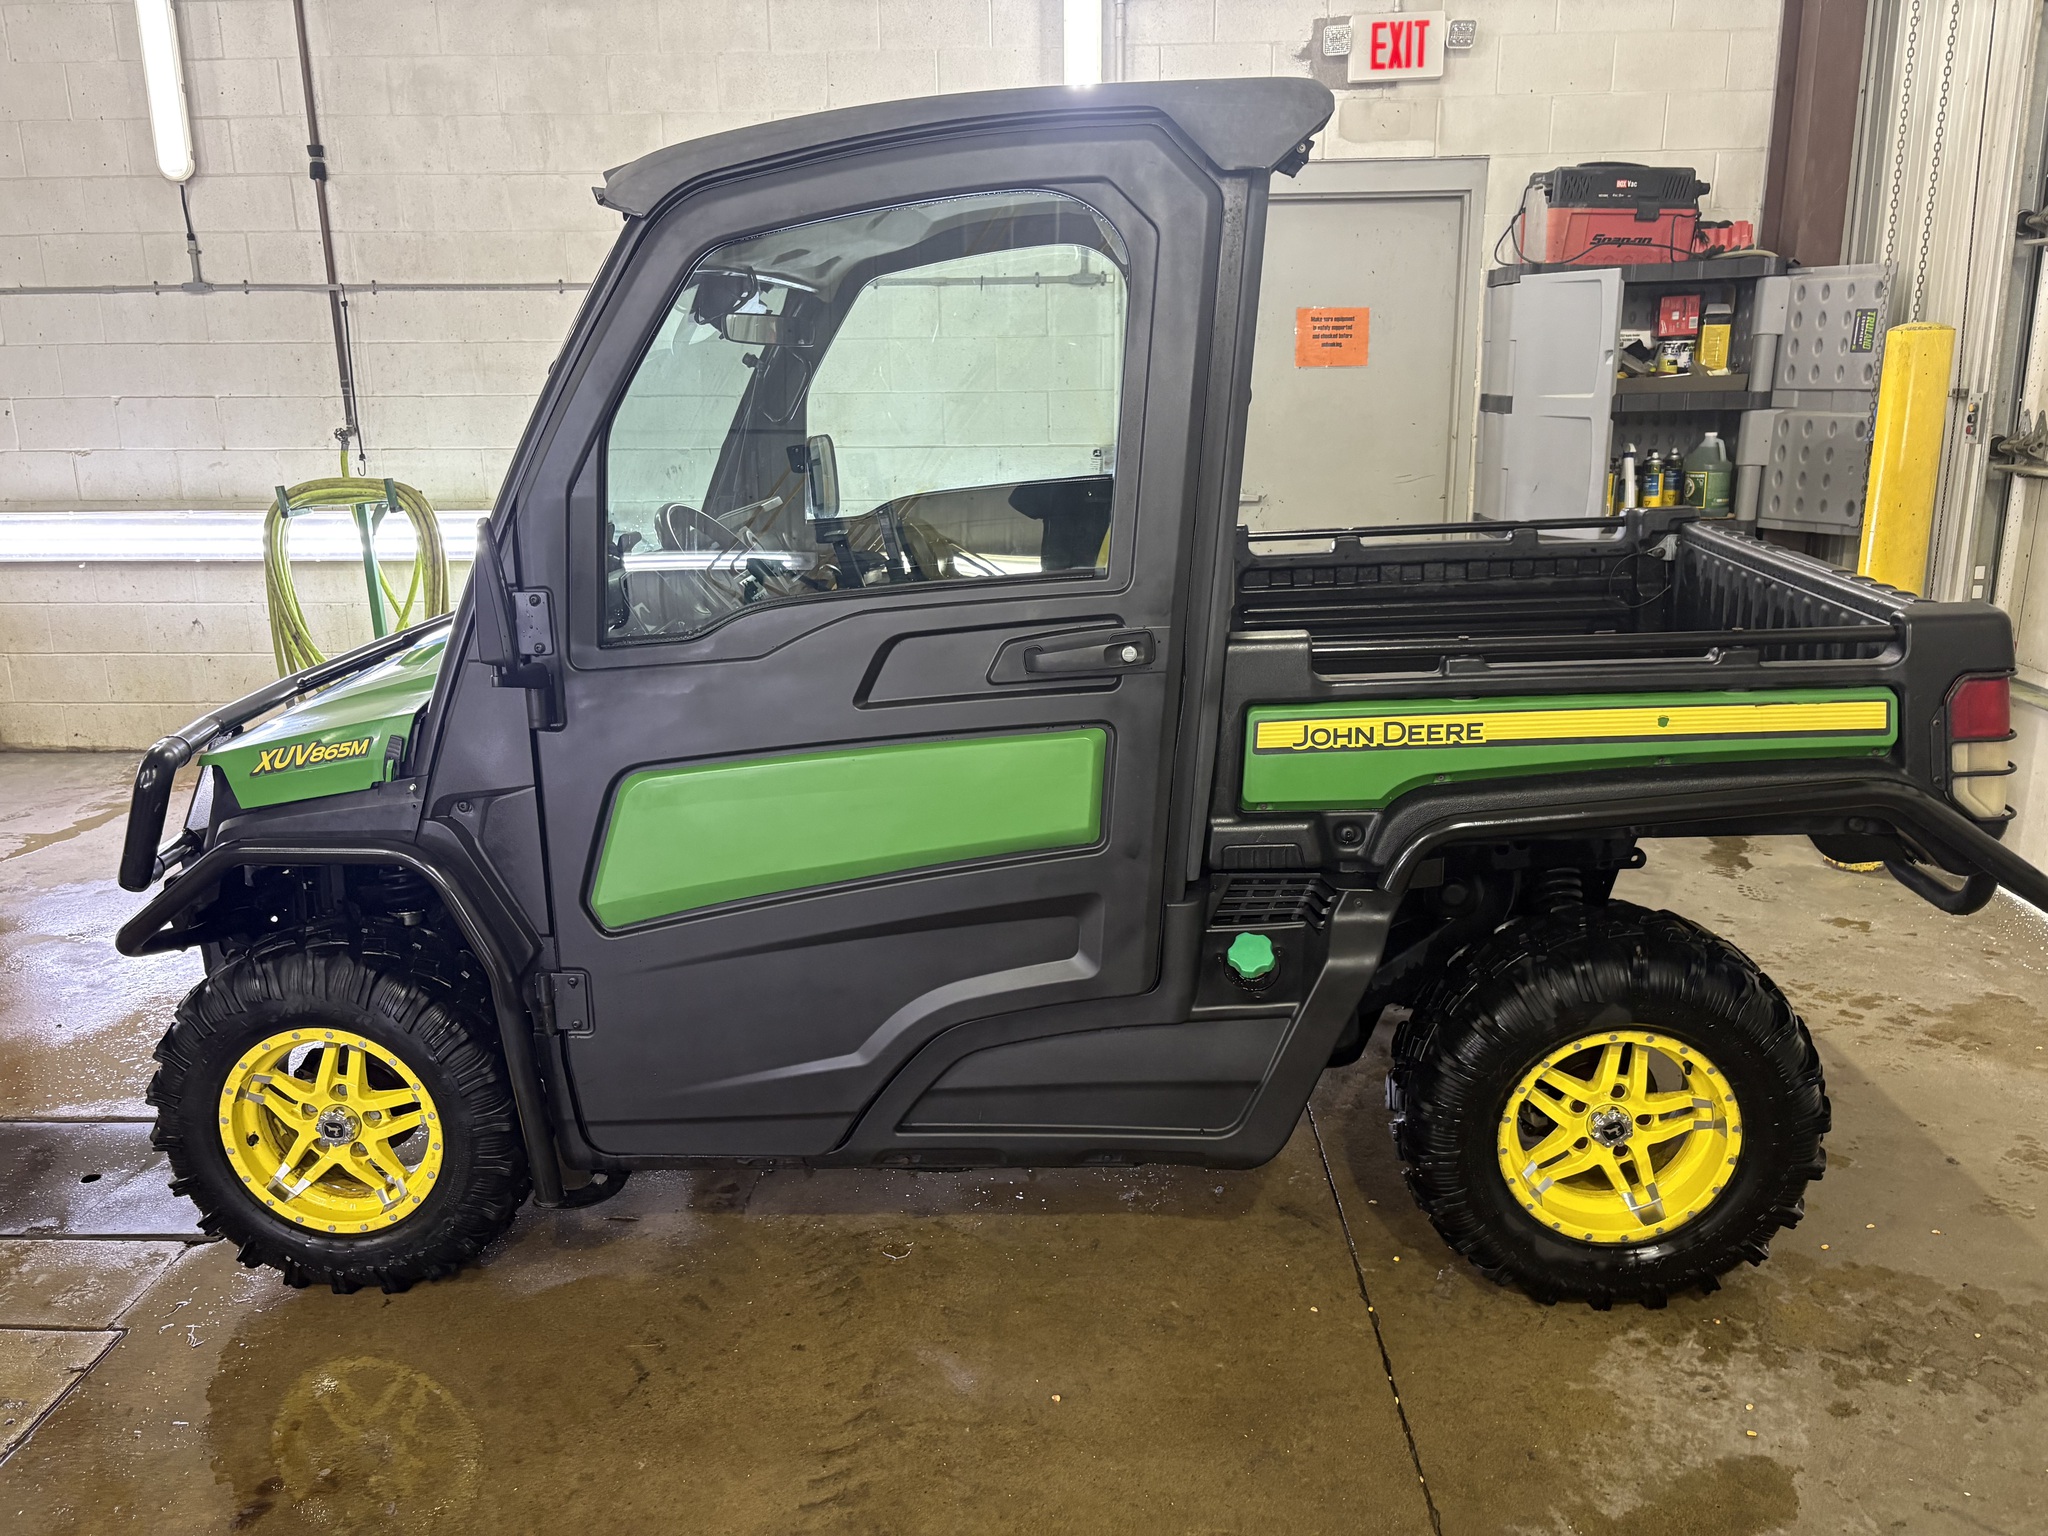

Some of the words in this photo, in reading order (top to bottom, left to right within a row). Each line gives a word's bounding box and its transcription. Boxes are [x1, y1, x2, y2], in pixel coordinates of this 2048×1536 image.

[1370, 20, 1430, 70] EXIT
[1590, 234, 1653, 248] Snap-on
[1863, 312, 1876, 349] TRULAND
[1292, 725, 1375, 747] JOHN
[1383, 721, 1484, 744] DEERE
[252, 738, 371, 775] XUV865M
